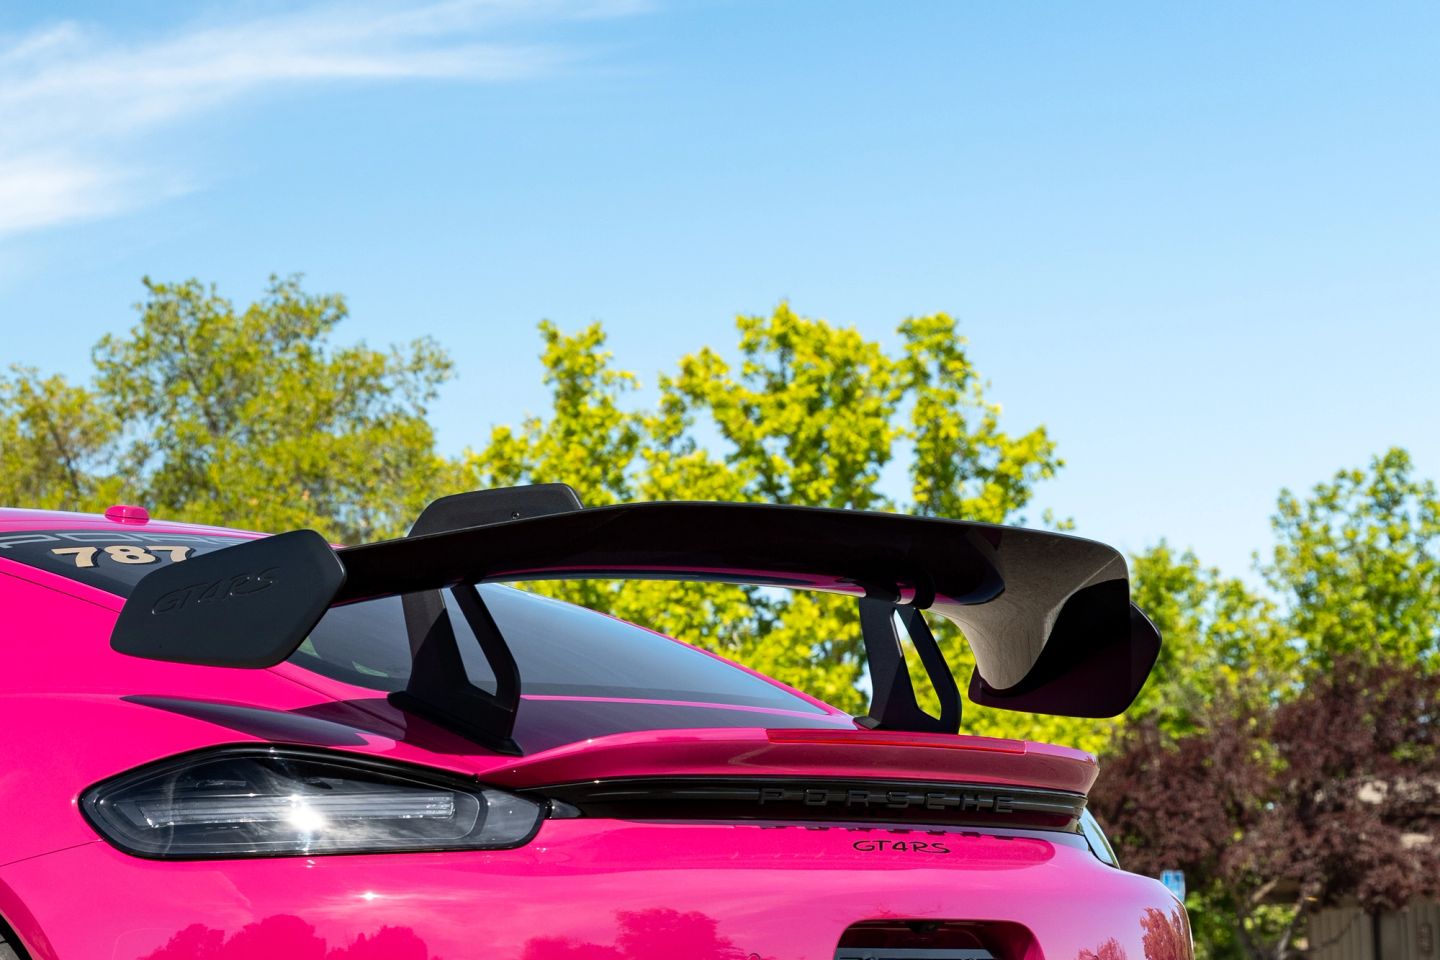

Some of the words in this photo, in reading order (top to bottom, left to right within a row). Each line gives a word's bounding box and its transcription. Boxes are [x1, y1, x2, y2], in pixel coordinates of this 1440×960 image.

[51, 545, 192, 568] 787
[760, 787, 1013, 814] PORSCHE
[852, 839, 951, 854] GT4RS
